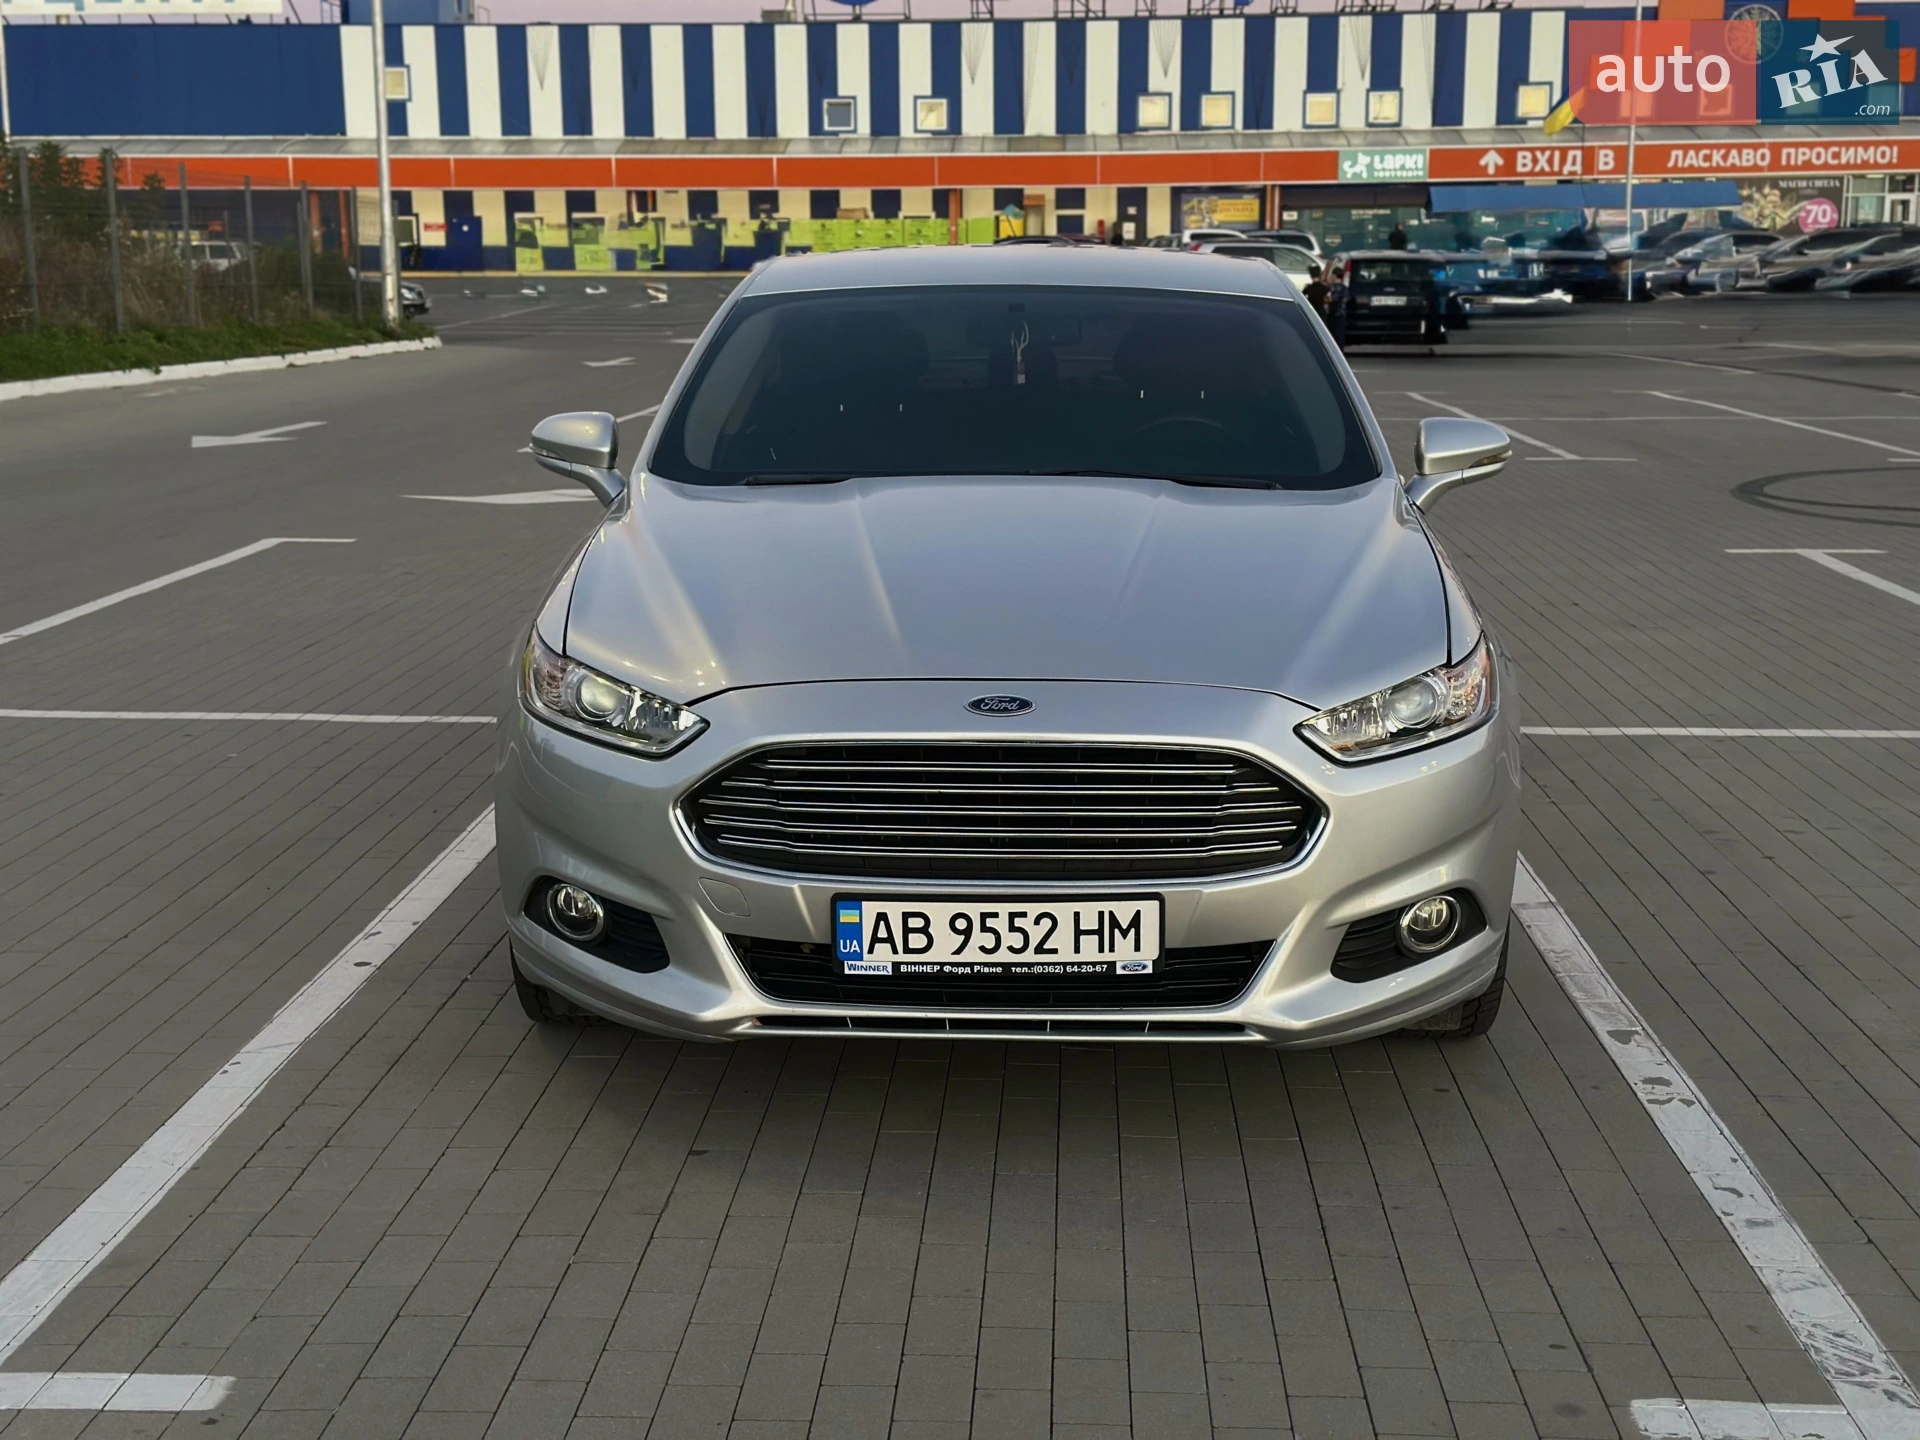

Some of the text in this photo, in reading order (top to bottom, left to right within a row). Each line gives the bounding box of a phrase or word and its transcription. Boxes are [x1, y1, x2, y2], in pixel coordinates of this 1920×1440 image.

[1516, 148, 1616, 175] ВХІД В
[1667, 145, 1899, 168] ЛАСКАВО ПРОСИМО!
[980, 697, 1020, 710] Ford
[866, 908, 1142, 956] AB 9552 HM
[840, 940, 861, 953] UA
[900, 964, 940, 973] ВІННЕР
[943, 964, 971, 974] Форд
[973, 964, 1003, 974] Рівне
[1066, 964, 1108, 973] 64-20-67
[1124, 961, 1144, 971] Ford
